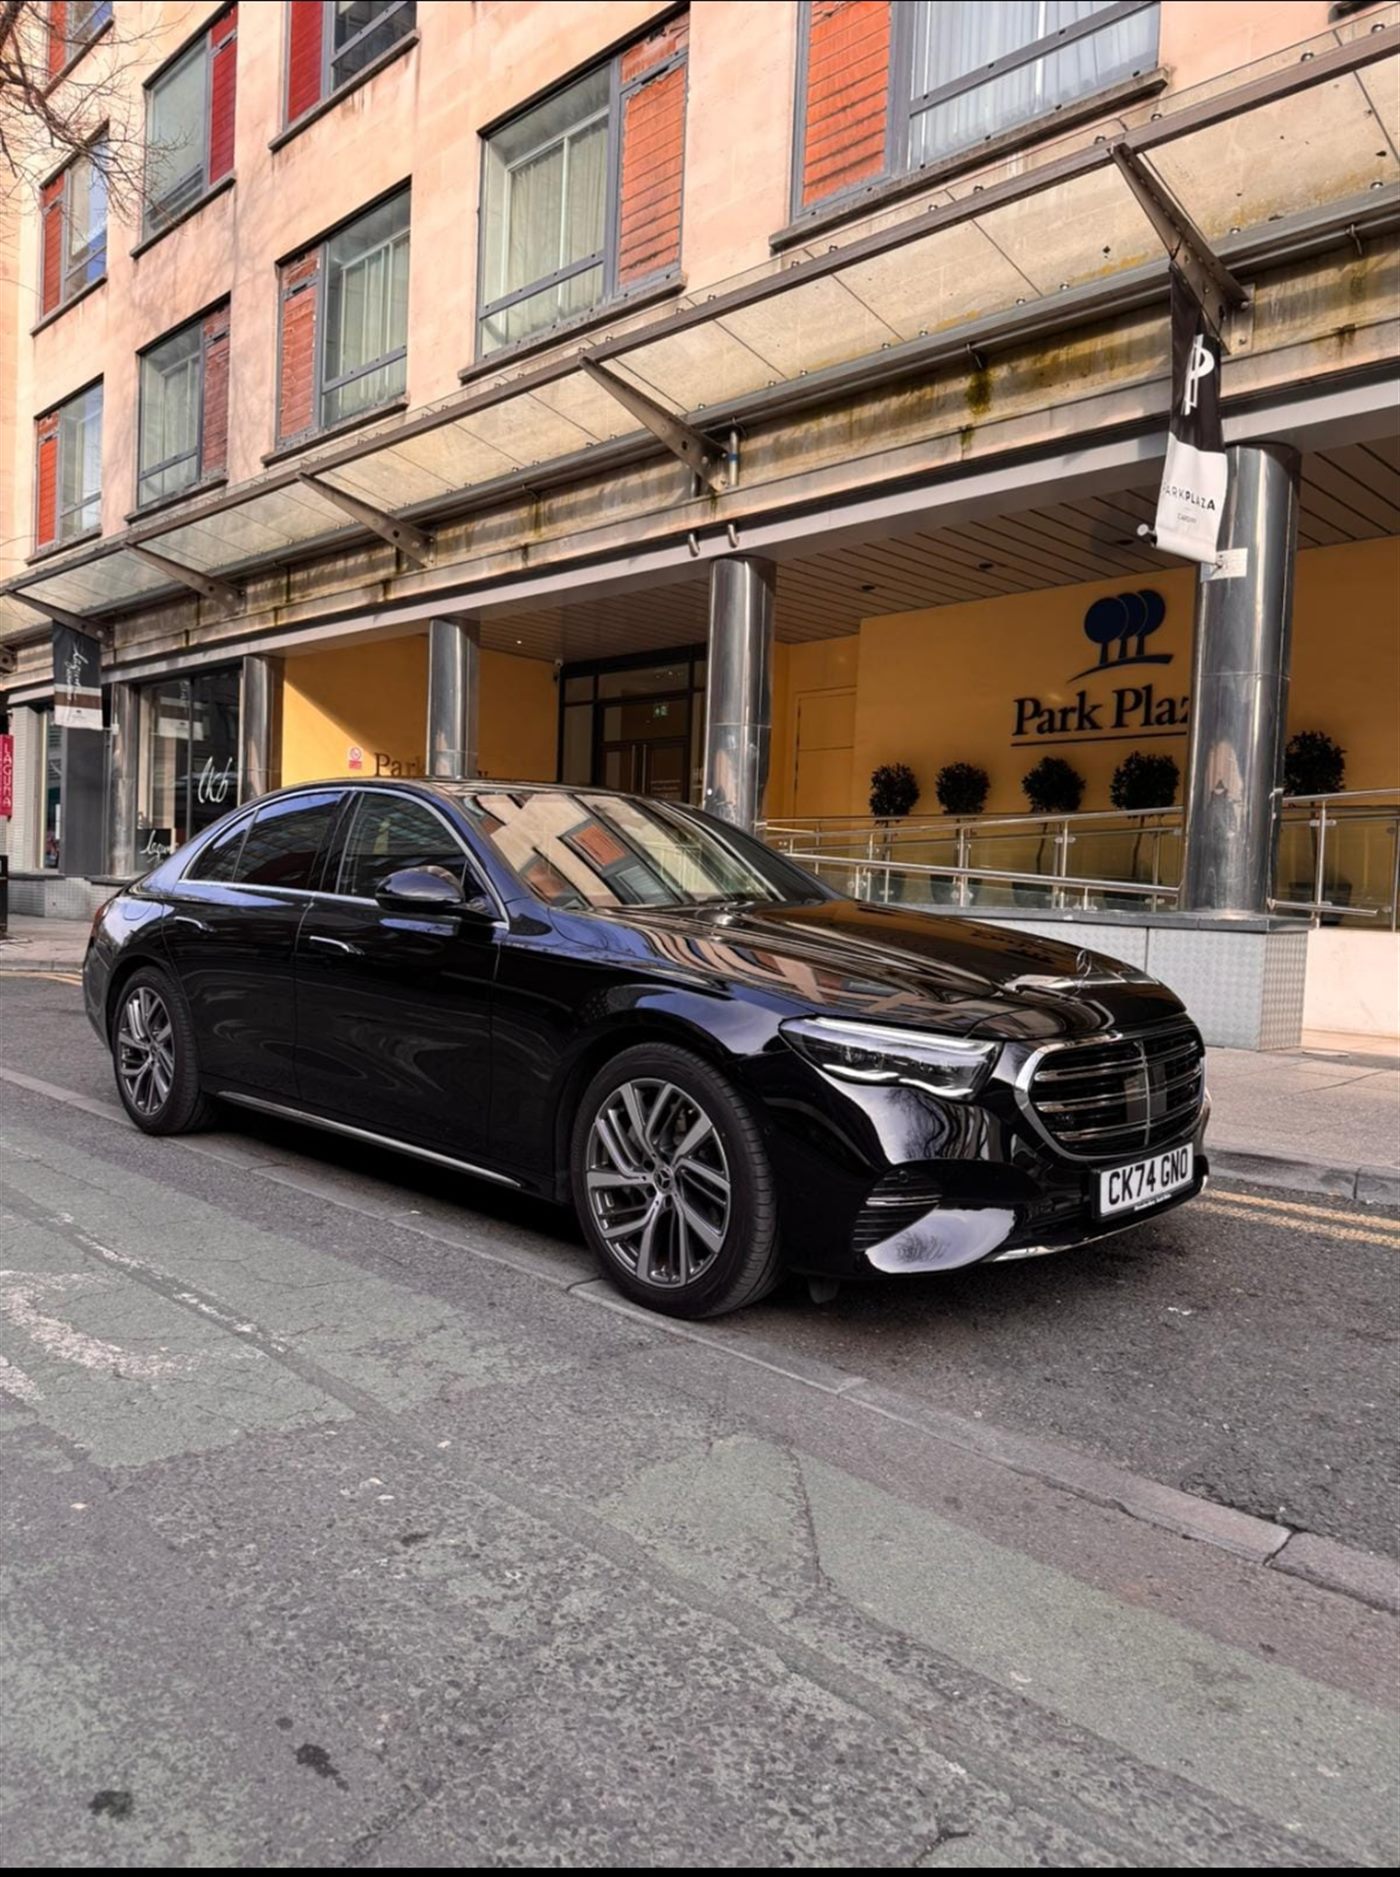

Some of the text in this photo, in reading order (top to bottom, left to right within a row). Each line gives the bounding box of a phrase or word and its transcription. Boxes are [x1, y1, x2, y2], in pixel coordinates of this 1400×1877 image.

[1012, 690, 1102, 736] Park
[1108, 1147, 1189, 1205] CK74 GNO
